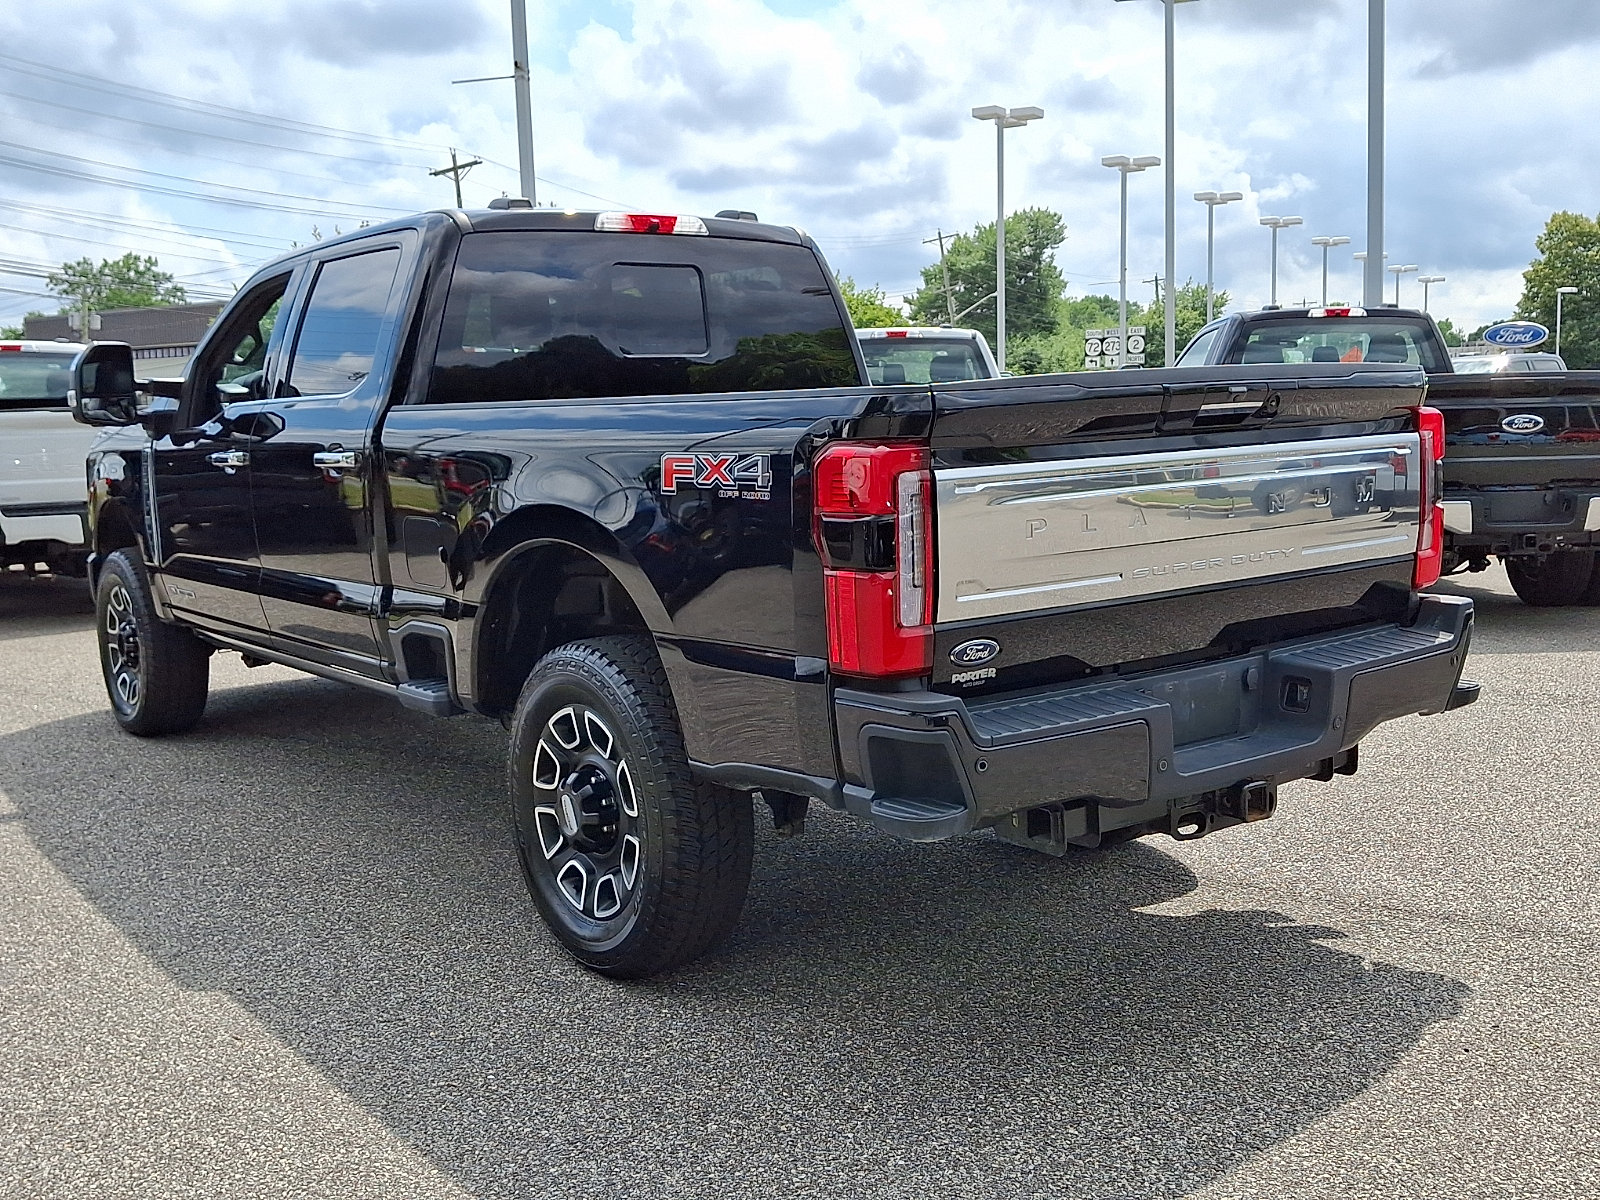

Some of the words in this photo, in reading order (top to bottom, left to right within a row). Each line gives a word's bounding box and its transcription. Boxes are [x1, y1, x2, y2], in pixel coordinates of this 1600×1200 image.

[1495, 327, 1533, 343] Ford
[1087, 342, 1100, 353] 72
[1104, 341, 1120, 352] 273
[1132, 339, 1140, 350] 2
[1511, 417, 1535, 429] Ford
[661, 452, 771, 495] FX4
[718, 490, 740, 498] OFF
[741, 491, 771, 500] ROAD
[1025, 476, 1376, 540] PLATINUM
[1132, 557, 1224, 579] SUPER
[1231, 547, 1295, 566] DUTY
[963, 645, 991, 661] Ford
[951, 667, 997, 684] PORTER
